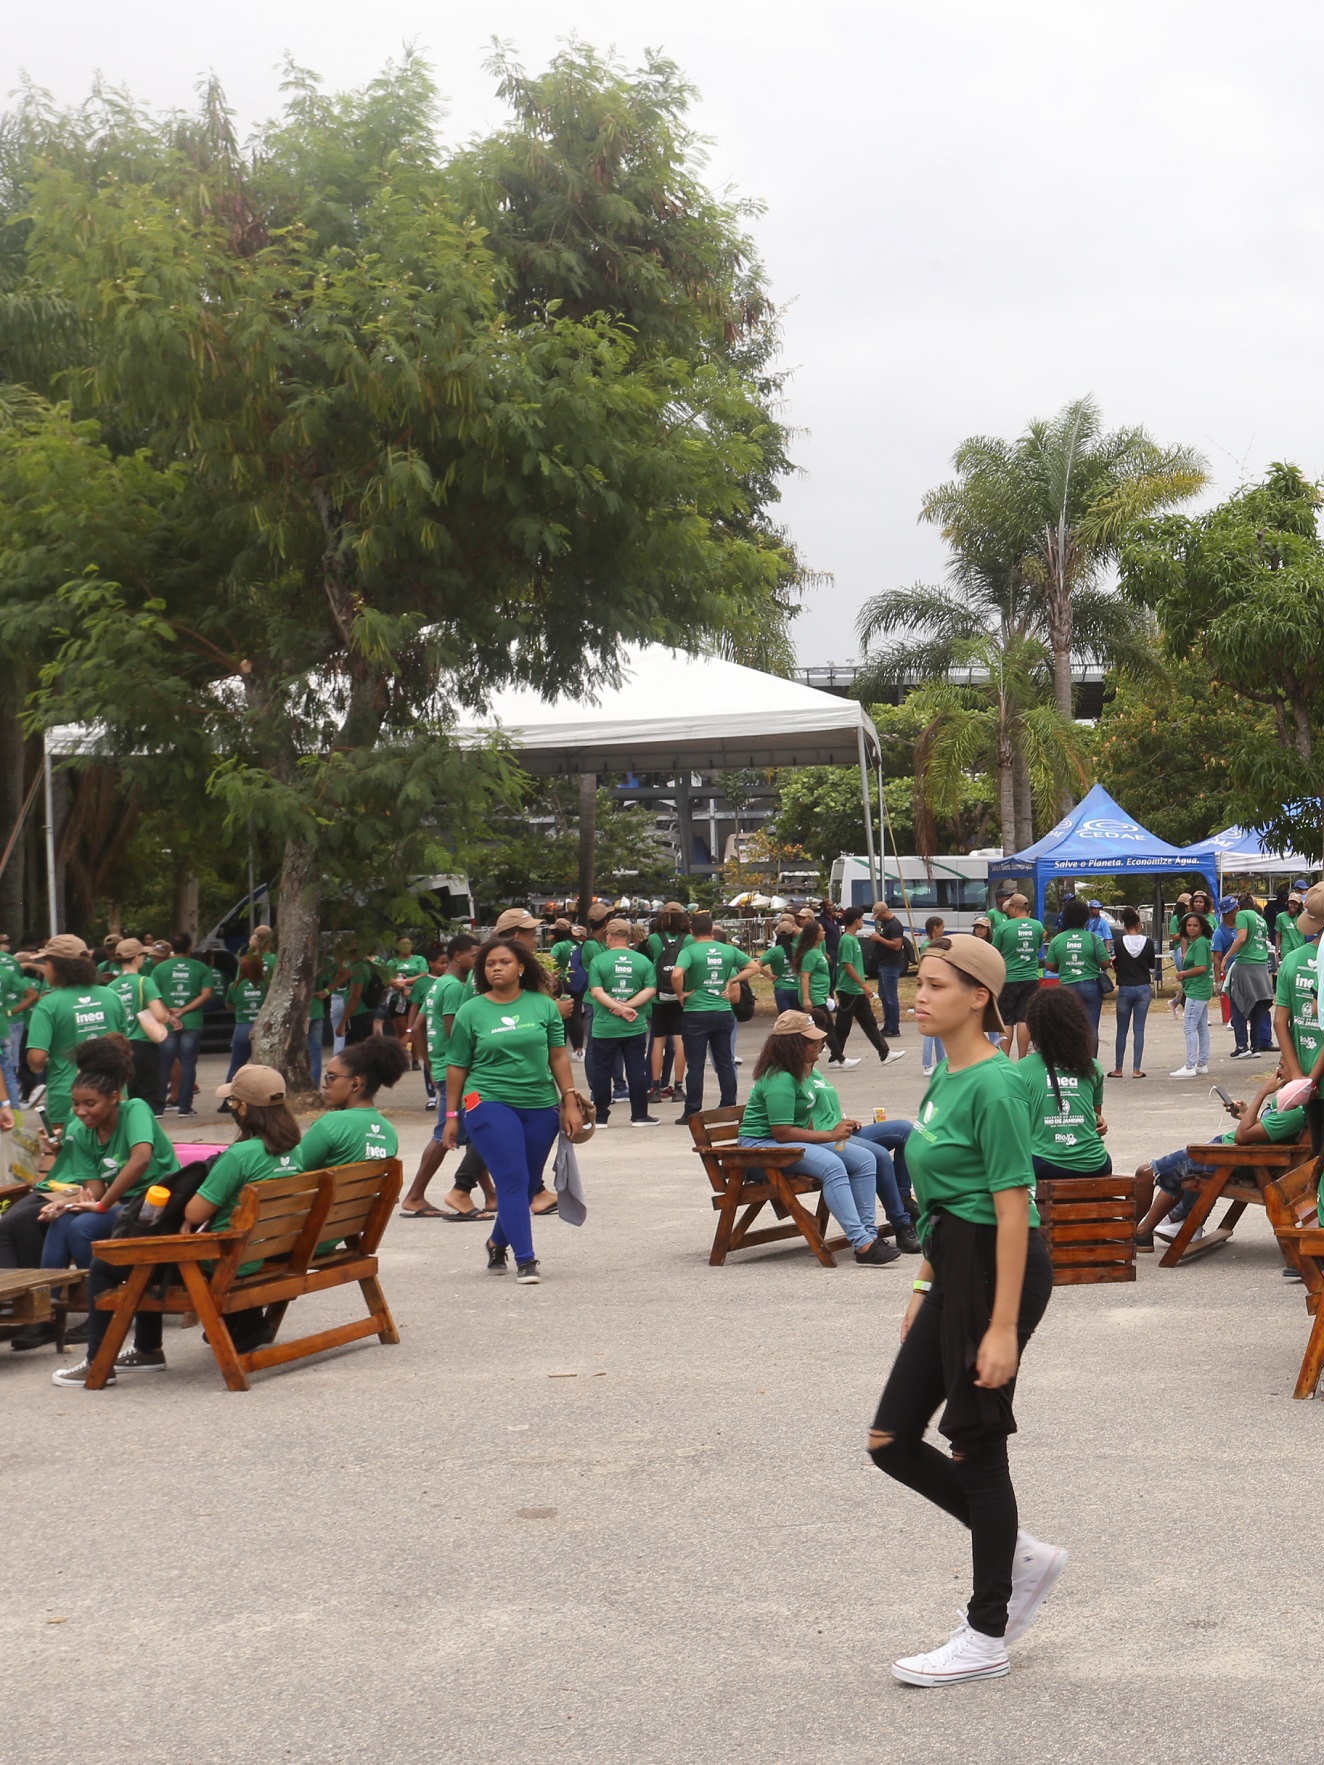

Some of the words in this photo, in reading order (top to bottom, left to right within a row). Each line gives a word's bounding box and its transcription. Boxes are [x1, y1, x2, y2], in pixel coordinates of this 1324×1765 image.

[1078, 831, 1147, 842] CEDAE
[1054, 859, 1078, 869] Salve
[1088, 858, 1124, 868] Planeta.
[1126, 857, 1173, 867] Economize
[1175, 855, 1200, 867] Água.
[1295, 973, 1315, 988] ine
[75, 1010, 105, 1024] inea
[365, 1142, 387, 1159] inea
